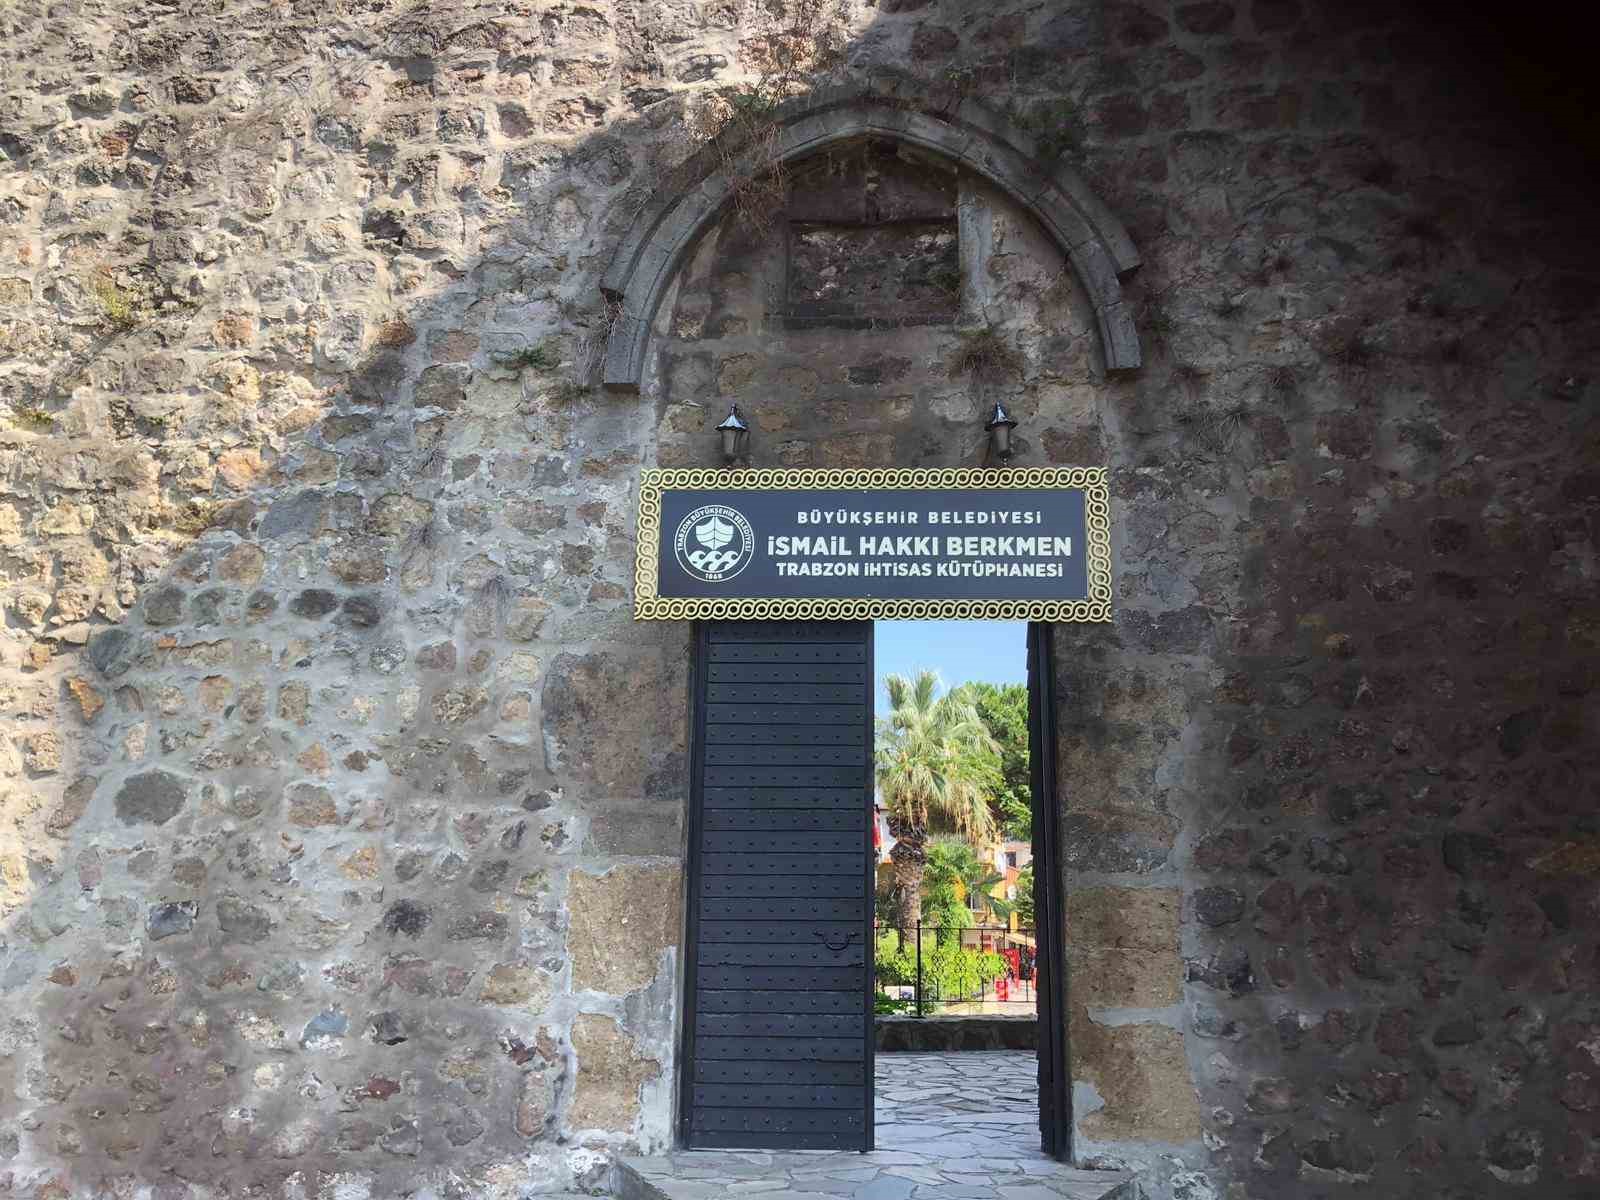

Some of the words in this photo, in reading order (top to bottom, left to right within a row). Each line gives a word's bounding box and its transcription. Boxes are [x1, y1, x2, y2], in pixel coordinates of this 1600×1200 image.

[798, 509, 919, 526] BÜYÜKŞEHİR
[928, 510, 1042, 525] BELEDİYESİ
[767, 536, 852, 556] İSMAİL
[859, 536, 939, 556] HAKKI
[946, 536, 1072, 556] BERKMEN
[776, 561, 860, 577] TRABZON
[864, 561, 932, 577] İHTİSAS
[937, 560, 1063, 577] KÜTÜPHANESİ
